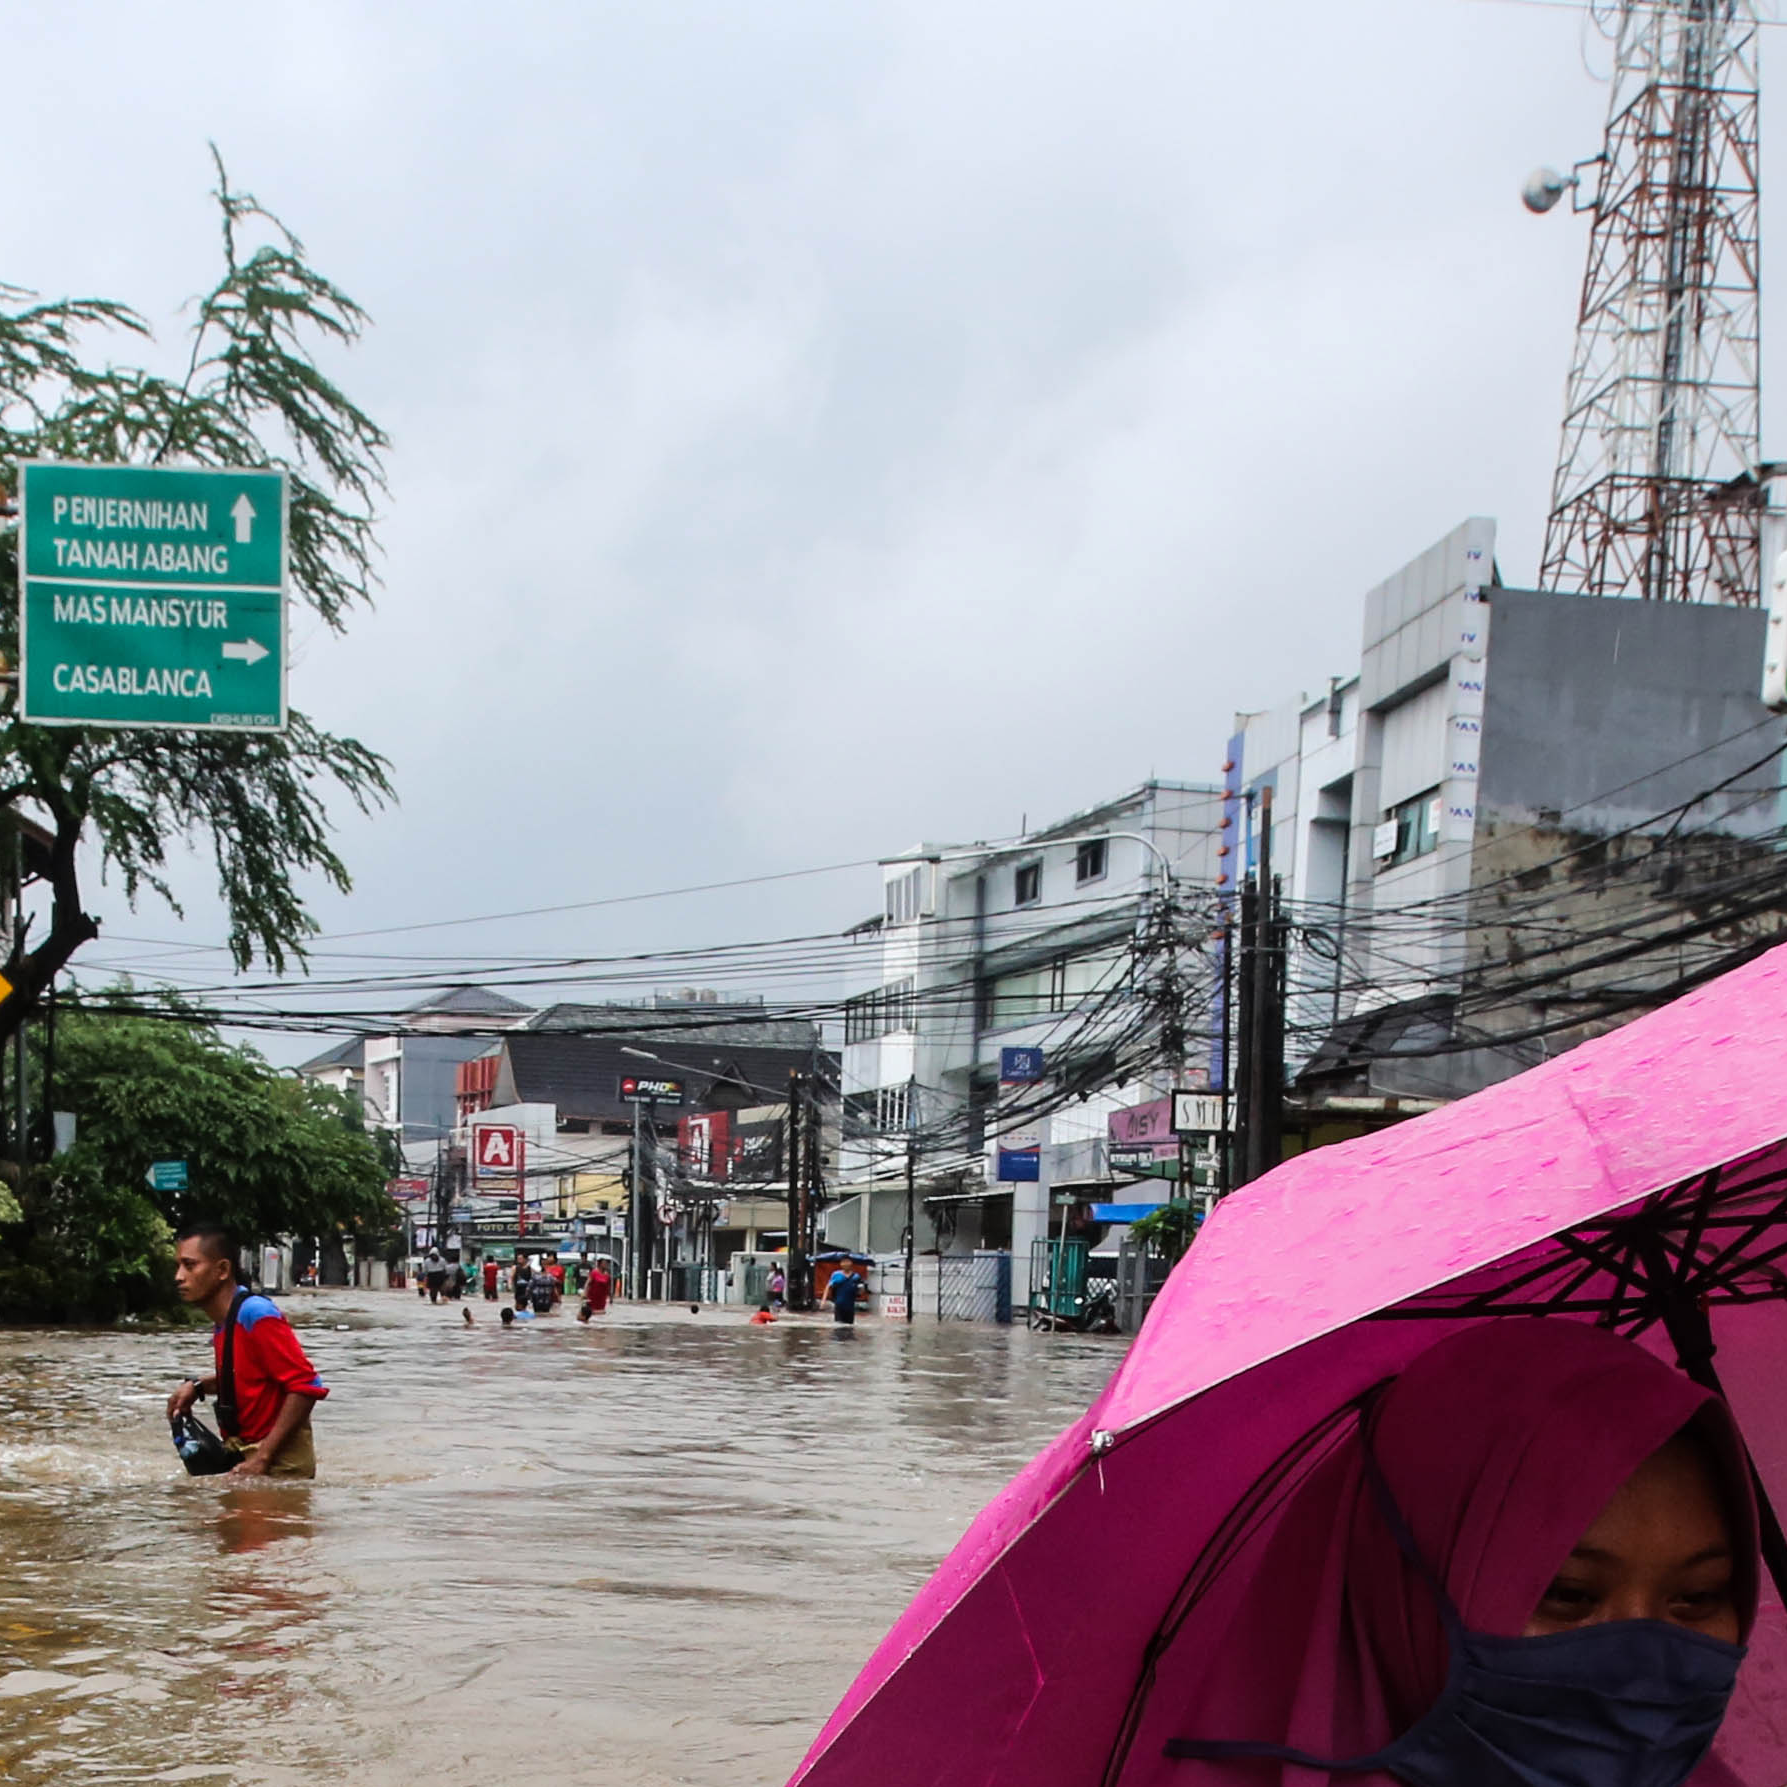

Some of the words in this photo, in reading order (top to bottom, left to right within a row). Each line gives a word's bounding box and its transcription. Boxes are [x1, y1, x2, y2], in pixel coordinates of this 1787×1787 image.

[53, 496, 208, 532] PENJERNIHAN
[53, 539, 138, 570] TANAH
[142, 543, 229, 574] ABANG
[53, 595, 108, 625] MAS
[111, 598, 229, 630] MANSYUR
[52, 664, 213, 698] CASABLANCA
